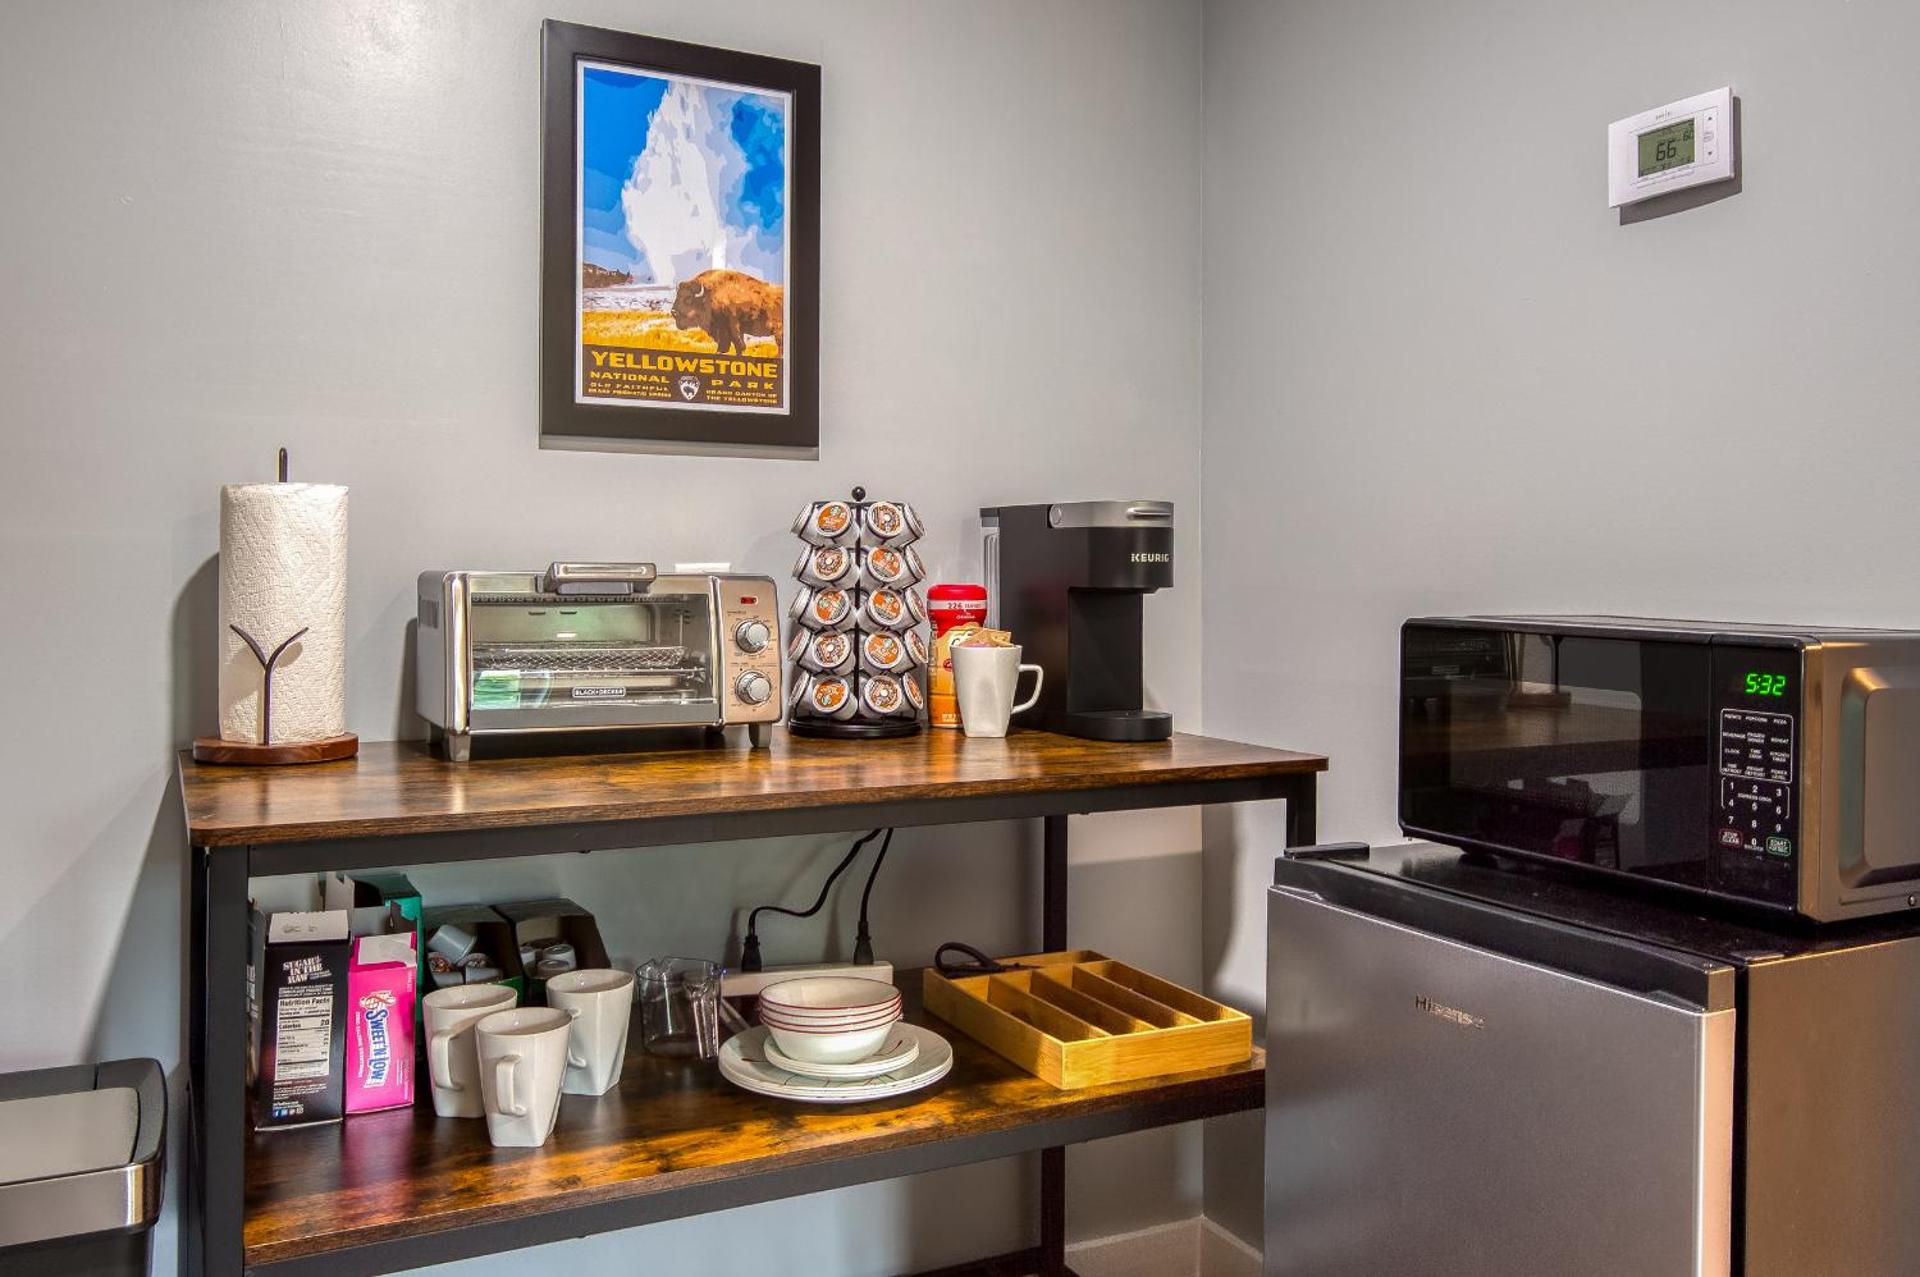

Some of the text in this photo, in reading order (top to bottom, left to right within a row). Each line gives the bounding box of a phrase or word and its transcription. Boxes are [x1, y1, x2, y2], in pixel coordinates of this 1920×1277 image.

[1656, 139, 1676, 161] 66
[591, 350, 778, 379] YELLOWSTONE
[590, 371, 774, 390] NATIONAL PARK
[1131, 553, 1170, 563] KEURIG
[1745, 673, 1786, 696] 5:32
[1730, 781, 1734, 790] 1
[1752, 784, 1758, 793] 2
[1776, 788, 1782, 797] 3
[1728, 799, 1734, 807] 4
[1776, 805, 1782, 815] 6
[1728, 815, 1734, 825] 7
[1751, 819, 1757, 829] 8
[1775, 823, 1782, 833] 9
